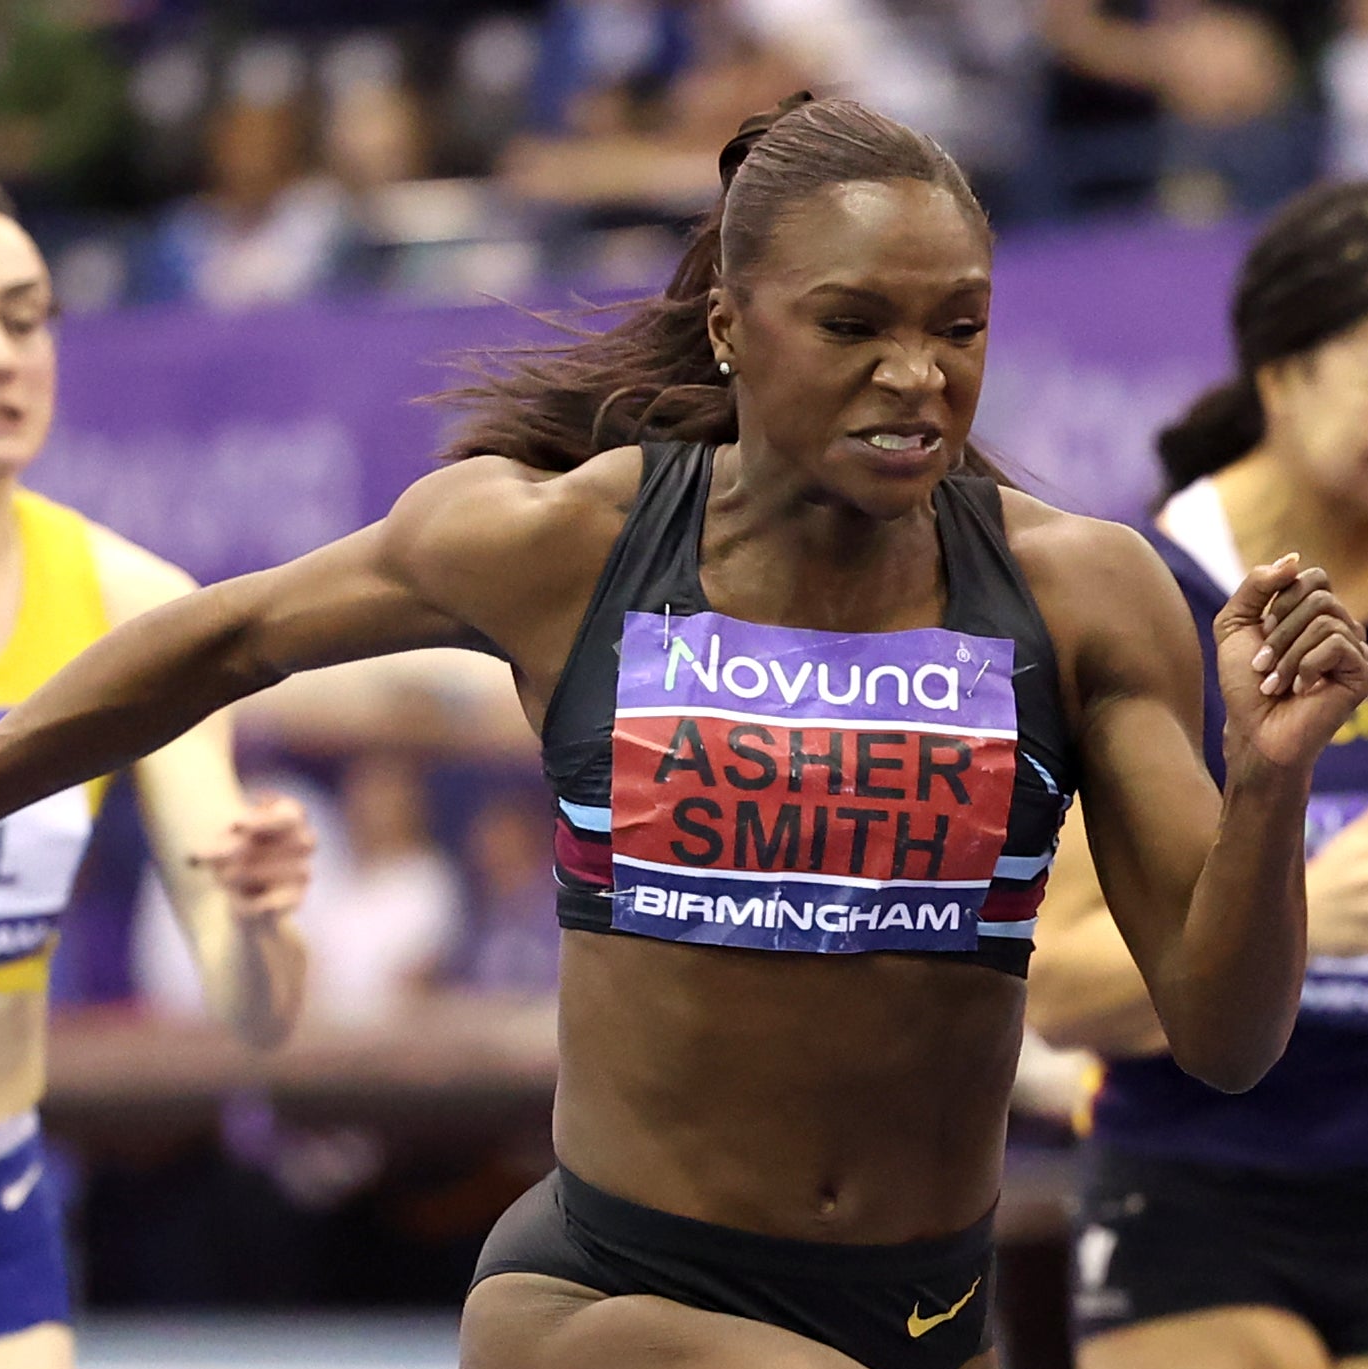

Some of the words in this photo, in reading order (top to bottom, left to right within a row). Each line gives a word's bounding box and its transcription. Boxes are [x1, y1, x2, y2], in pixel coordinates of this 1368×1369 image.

[663, 634, 961, 711] Novuna
[653, 719, 973, 804] ASHER
[669, 799, 949, 880] SMITH
[633, 884, 961, 932] BIRMINGHAM
